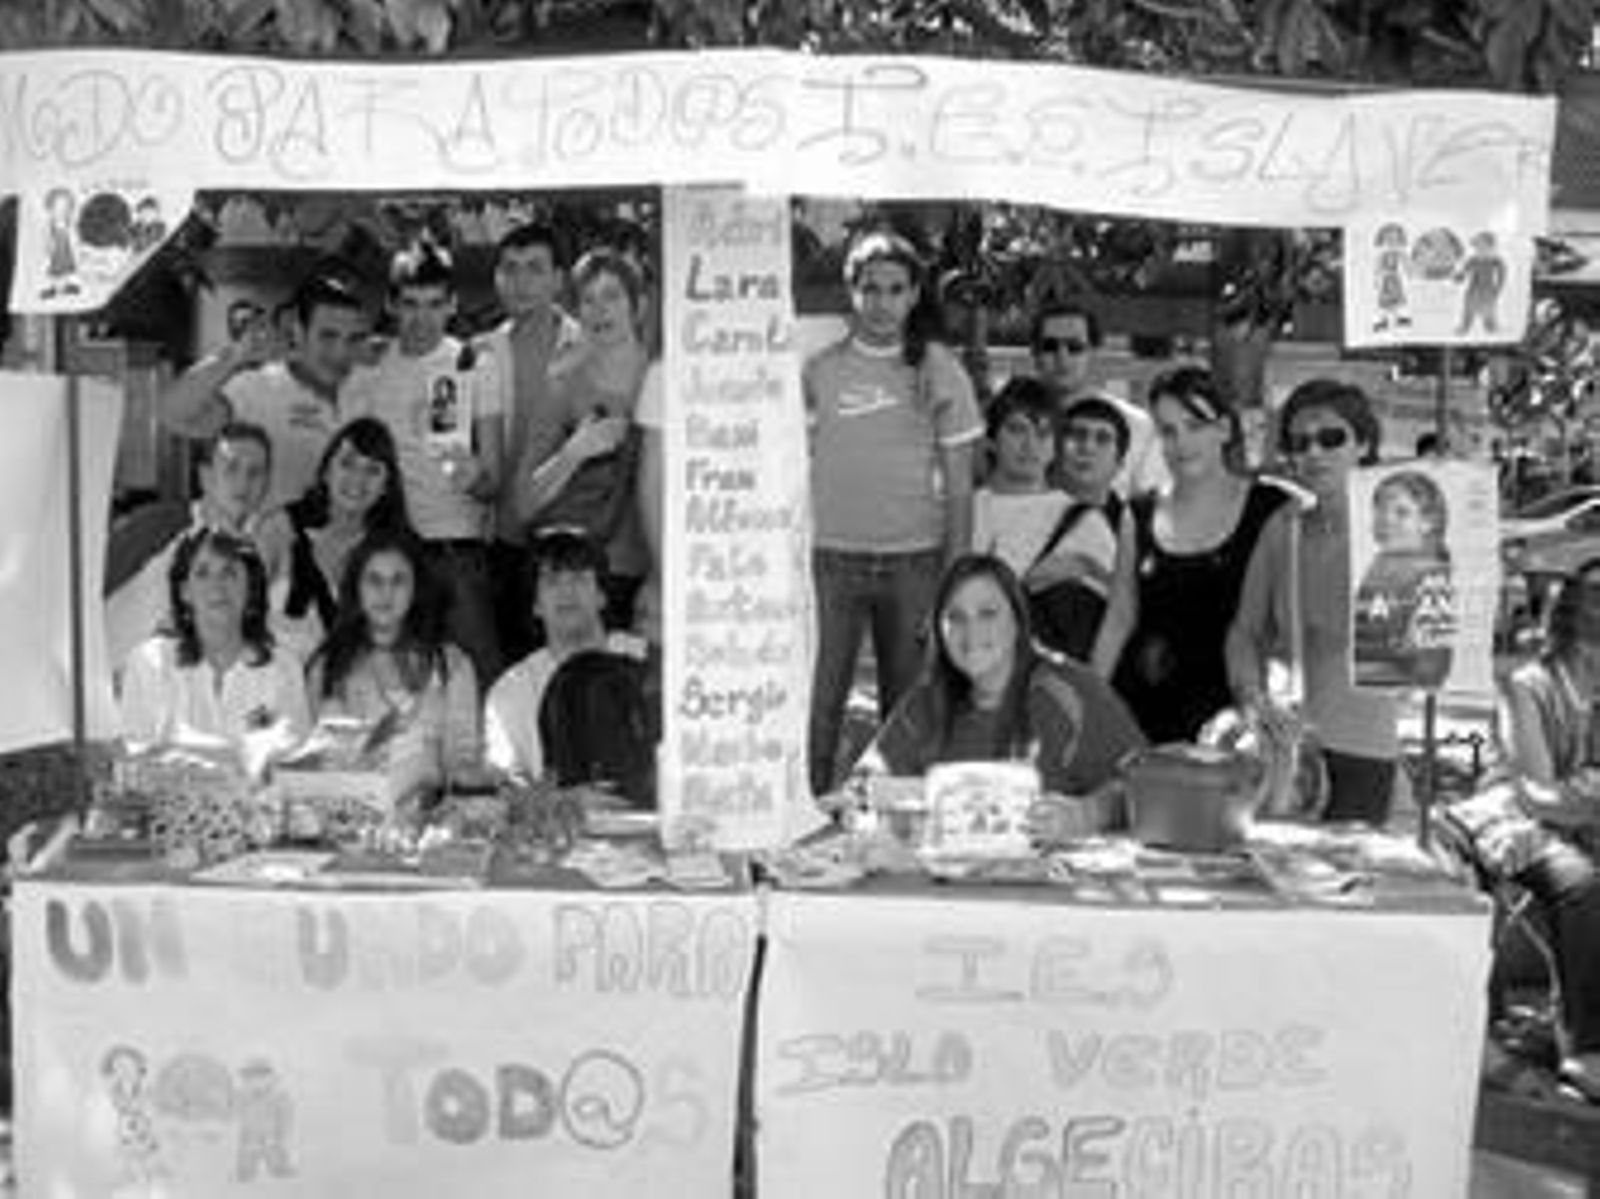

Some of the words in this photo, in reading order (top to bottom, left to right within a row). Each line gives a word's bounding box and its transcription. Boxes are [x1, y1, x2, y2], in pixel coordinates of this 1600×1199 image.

[686, 254, 781, 301] Lara
[47, 899, 190, 986] UN
[343, 1034, 712, 1152] TOD@S
[1047, 1020, 1331, 1101] VERDE
